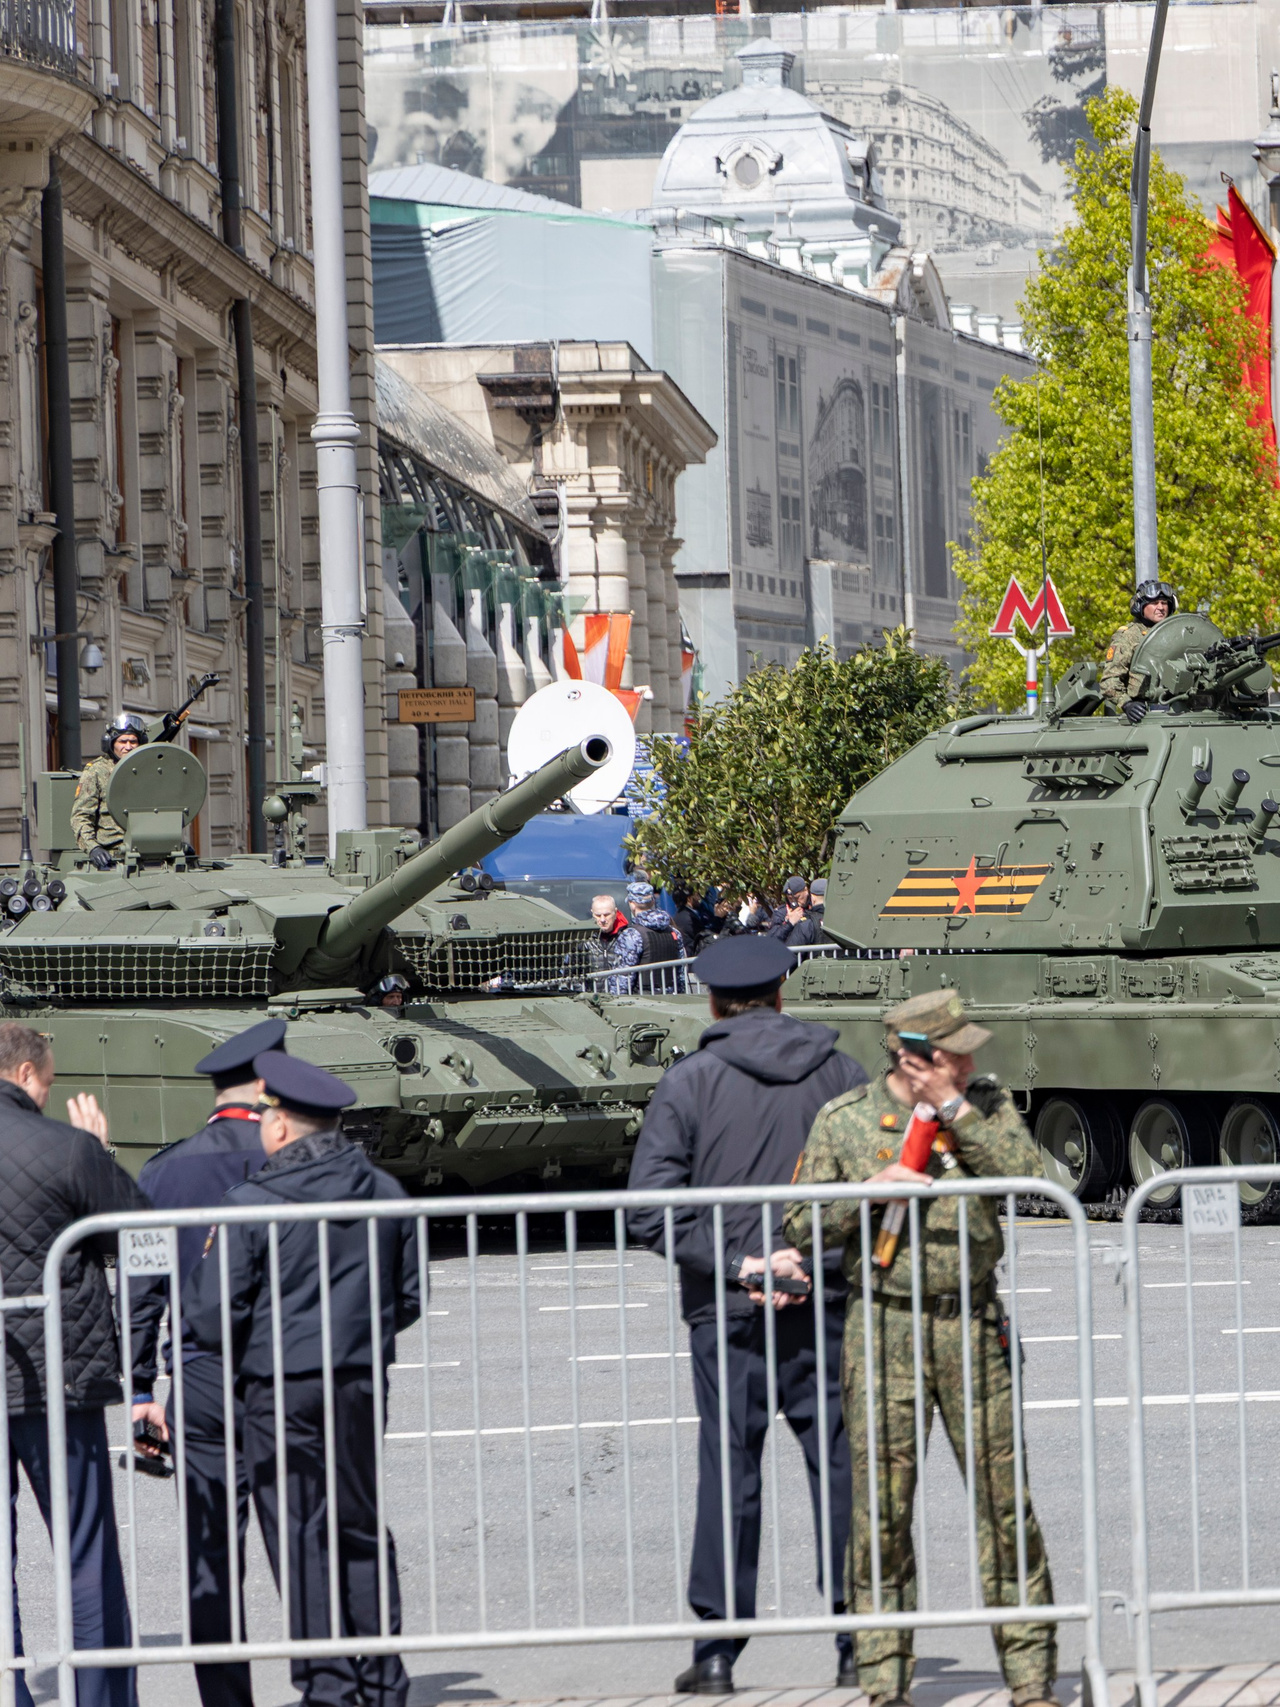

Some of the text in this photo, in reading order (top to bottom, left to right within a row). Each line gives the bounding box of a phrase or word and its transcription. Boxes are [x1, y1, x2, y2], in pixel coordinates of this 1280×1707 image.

[400, 690, 472, 699] ПЕТРОВСКИЙ ЗАЛ
[405, 699, 447, 707] PETROVSKY
